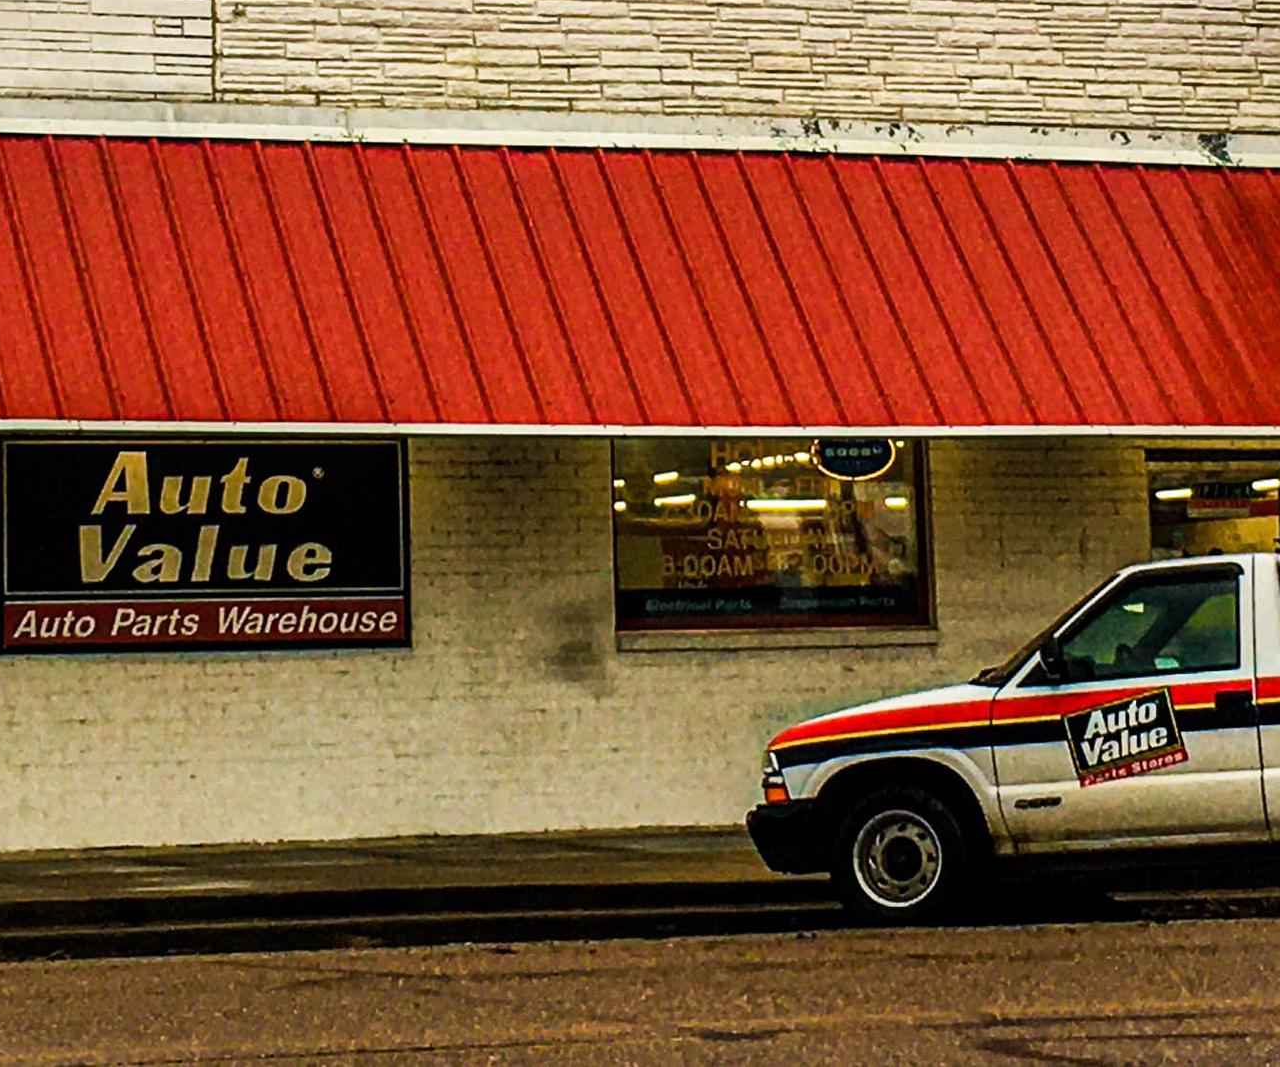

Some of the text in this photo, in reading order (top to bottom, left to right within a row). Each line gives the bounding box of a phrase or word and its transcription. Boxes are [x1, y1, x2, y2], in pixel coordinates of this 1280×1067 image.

[90, 450, 308, 515] Auto
[78, 524, 333, 584] Value
[13, 605, 398, 639] Auto Parts Warehouse
[715, 598, 752, 610] Parts
[1083, 699, 1157, 739] Auto
[1081, 727, 1167, 766] Value
[1131, 752, 1183, 774] Stores
